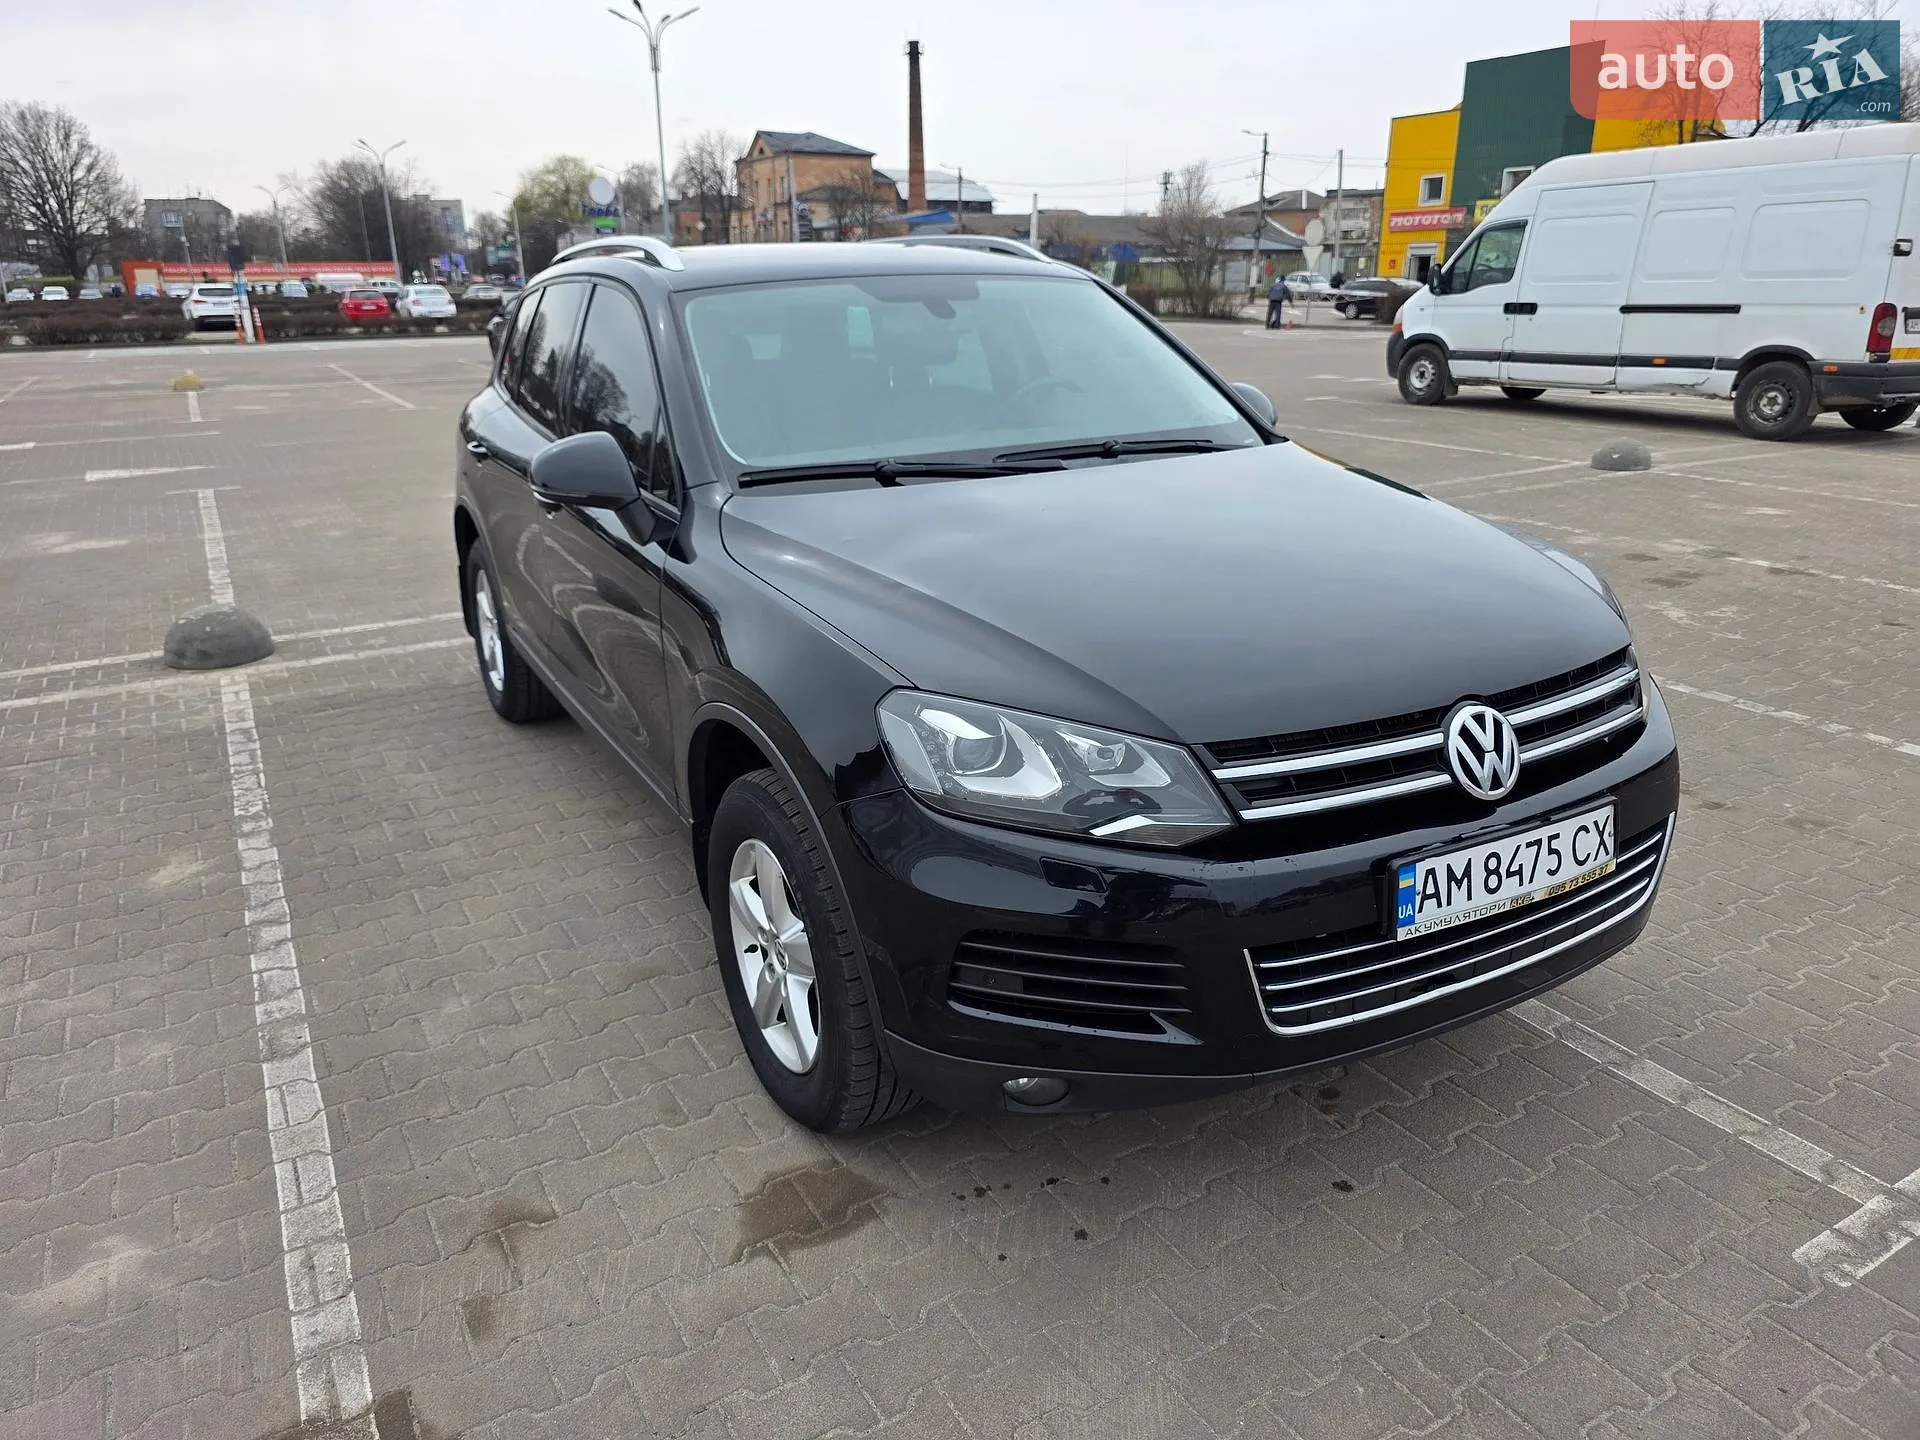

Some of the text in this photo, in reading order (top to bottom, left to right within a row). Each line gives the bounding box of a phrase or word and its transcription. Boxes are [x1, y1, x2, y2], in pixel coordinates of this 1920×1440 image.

[1417, 814, 1610, 914] AM 8475 CX
[1398, 903, 1414, 919] UA
[1404, 901, 1506, 938] АКУМУЛЯТОРИ
